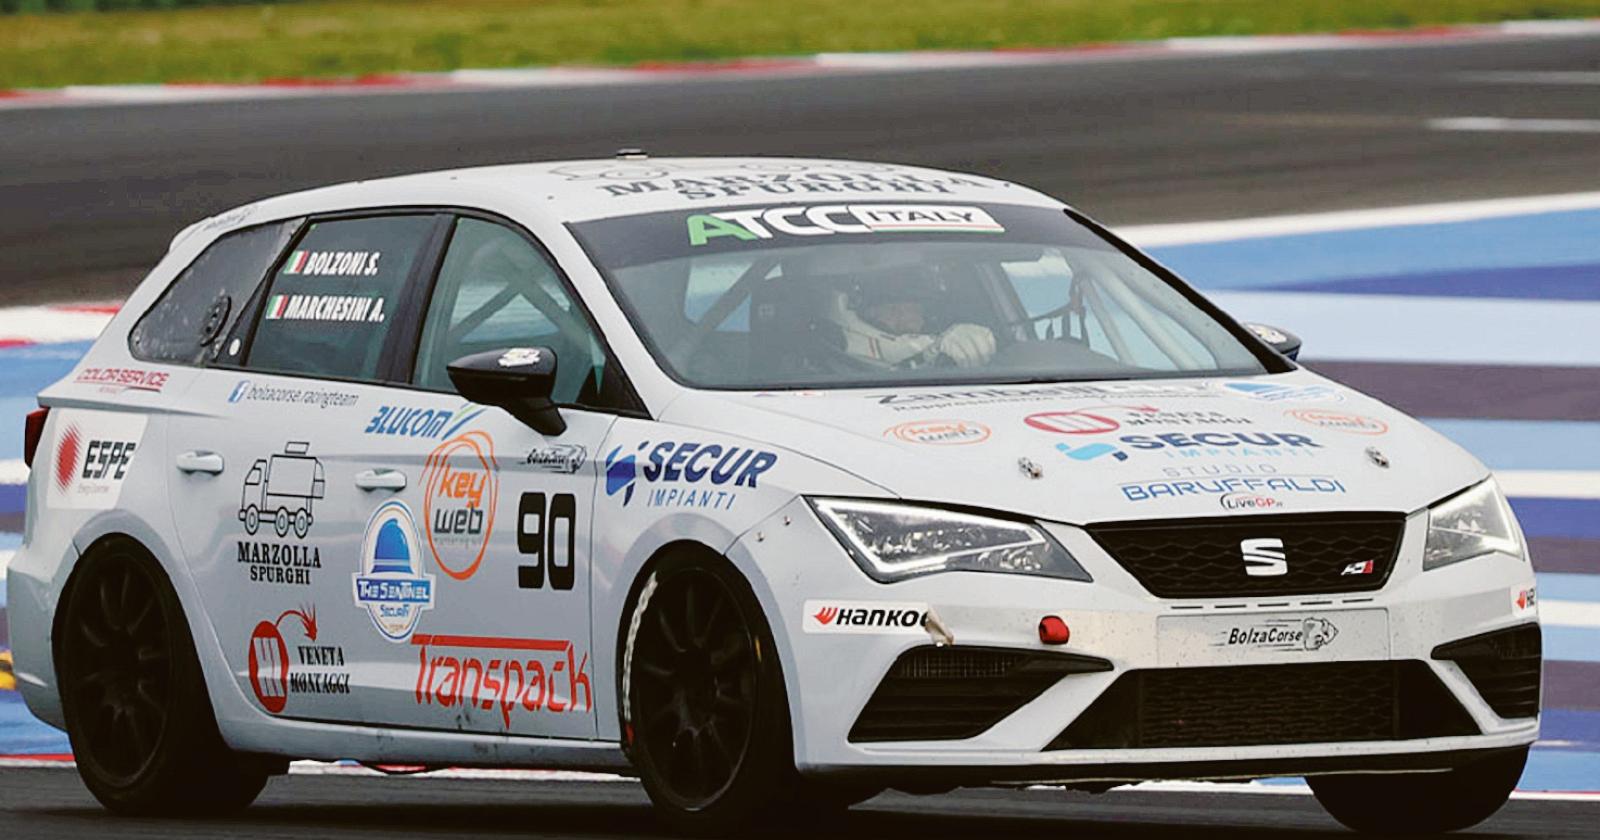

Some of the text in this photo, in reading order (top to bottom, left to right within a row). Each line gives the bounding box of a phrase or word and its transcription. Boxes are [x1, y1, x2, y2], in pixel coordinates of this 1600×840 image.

[677, 181, 955, 200] SPURGHI
[687, 205, 872, 246] ATCC
[866, 210, 974, 222] ITALY
[303, 251, 380, 276] BOLZONI S.
[283, 295, 386, 322] MARCHESINI A.
[1120, 432, 1324, 449] SECUR
[82, 440, 137, 479] ESPE
[642, 441, 778, 488] SECUR
[1163, 448, 1315, 458] IMPIANTI
[1163, 463, 1277, 477] STUDIO
[438, 464, 487, 508] key
[1122, 478, 1347, 501] BARUFFALDI
[647, 489, 737, 510] IMPIANTI
[434, 503, 484, 534] web
[517, 492, 576, 590] 90
[237, 541, 322, 569] MARZOLLA
[250, 566, 311, 585] SPURGHI
[1229, 628, 1303, 645] BolzaCorse
[298, 645, 345, 667] VENETA
[289, 673, 351, 695] MONTAGGI
[411, 633, 592, 730] Transpack
